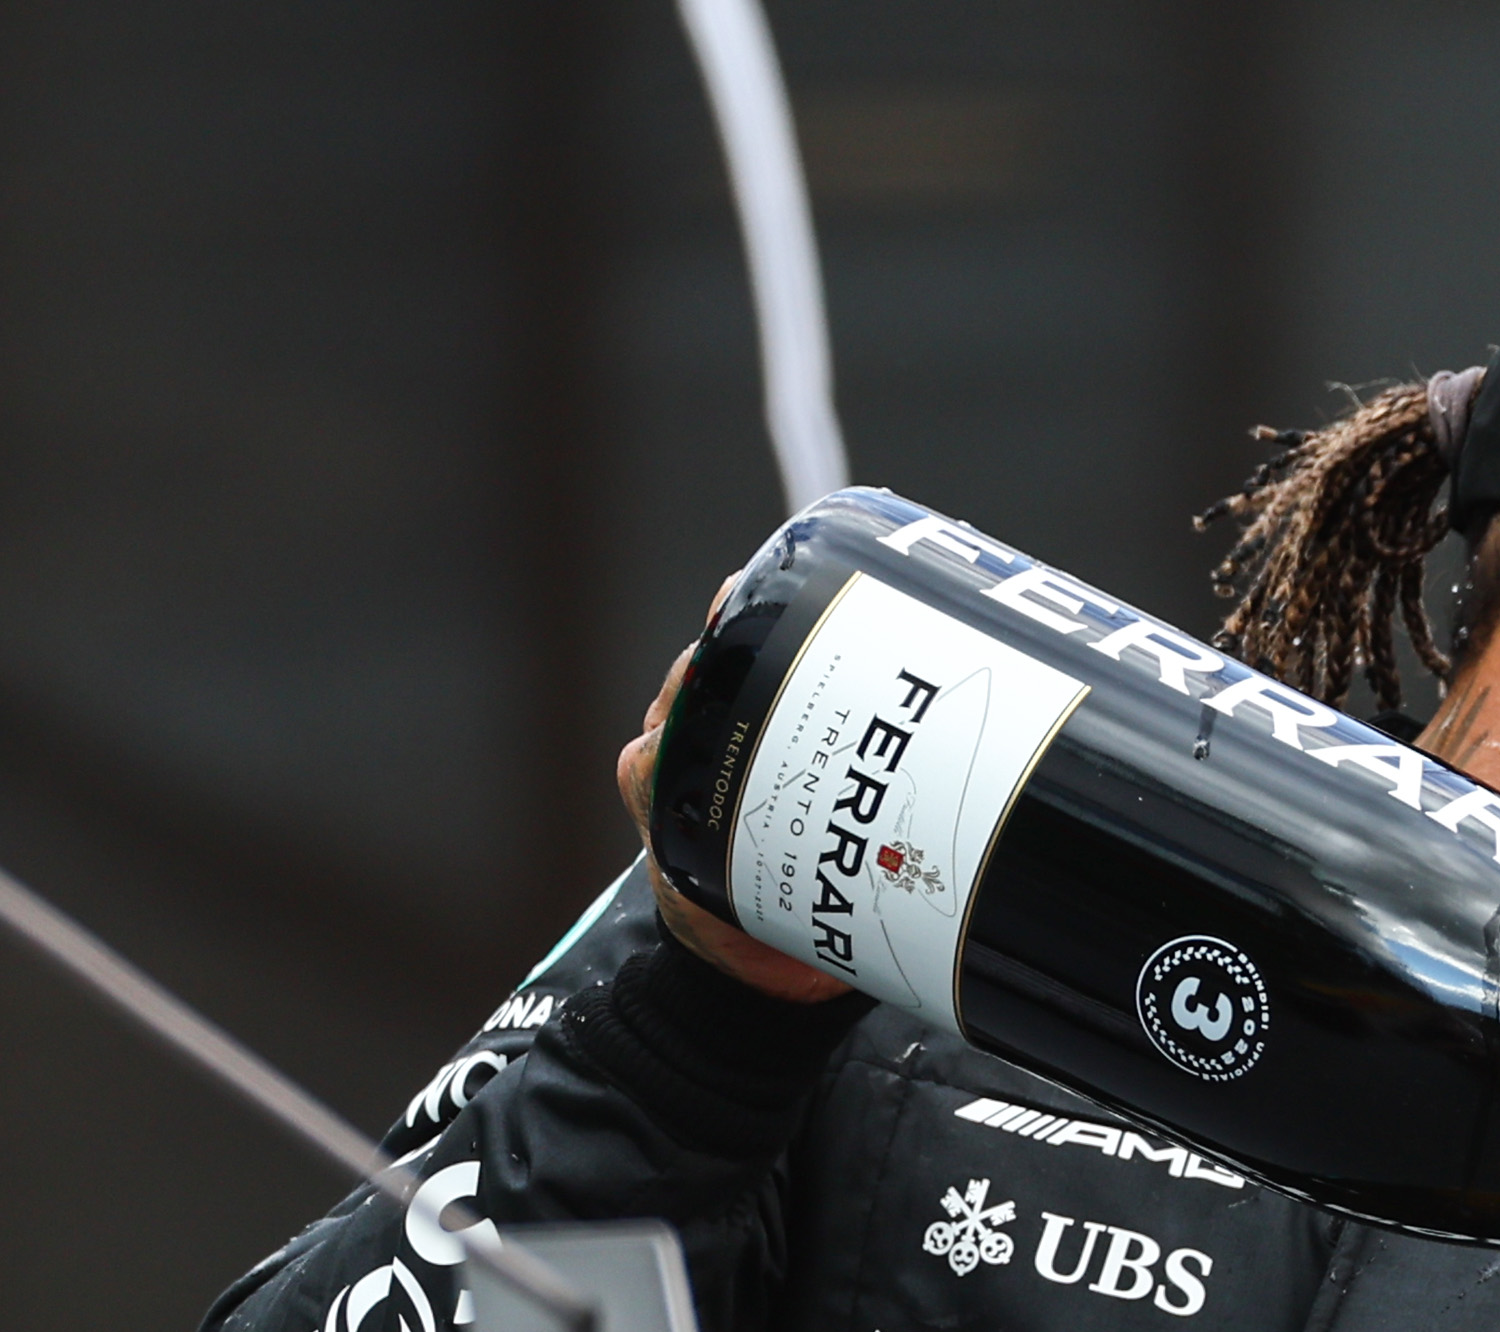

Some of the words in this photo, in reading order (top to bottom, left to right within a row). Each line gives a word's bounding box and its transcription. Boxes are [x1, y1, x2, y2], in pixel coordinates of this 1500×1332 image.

[707, 720, 751, 832] TRENTODOC
[789, 708, 852, 838] TRENTO
[811, 667, 942, 977] FERRARI
[778, 850, 799, 913] 1902
[1171, 976, 1233, 1042] 3
[1220, 996, 1256, 1065] 2022
[1046, 1120, 1246, 1189] AMG
[1033, 1210, 1214, 1317] UBS
